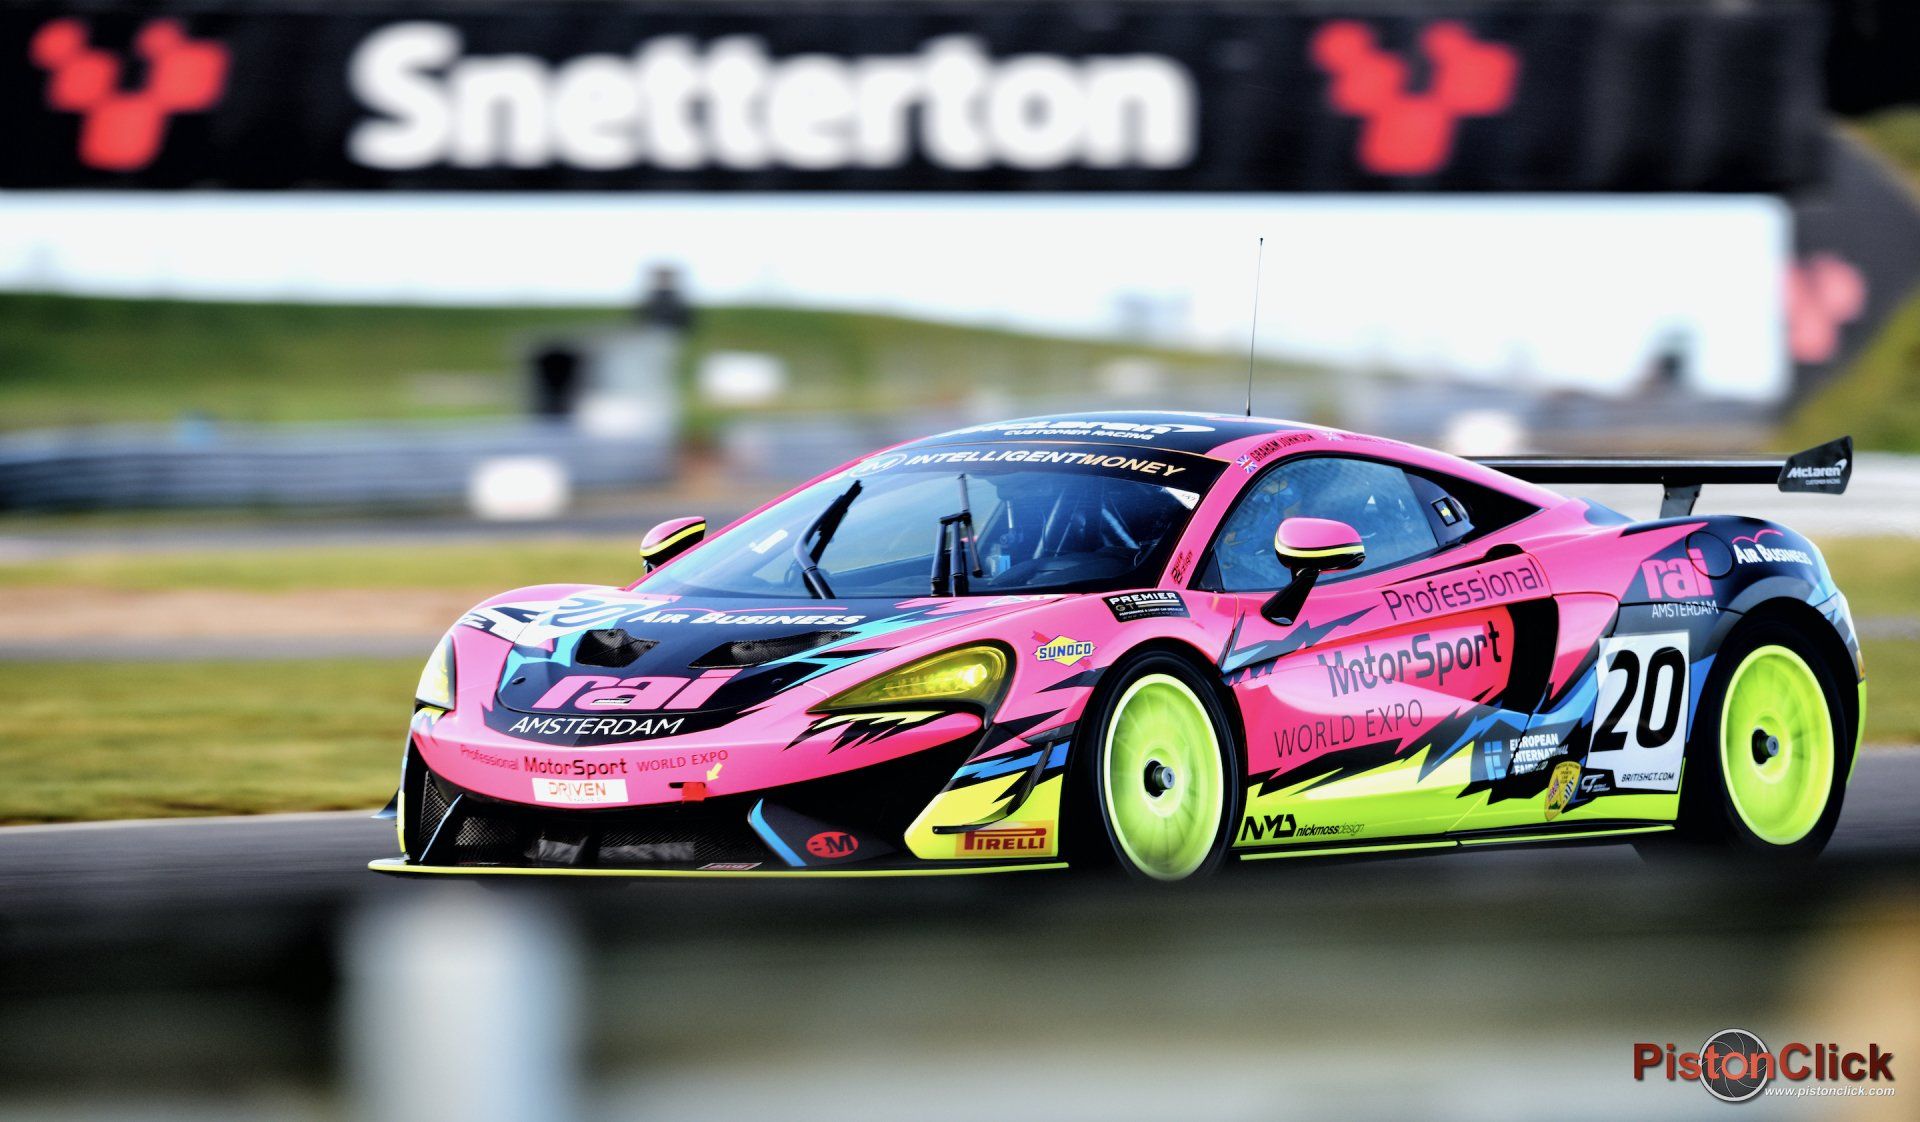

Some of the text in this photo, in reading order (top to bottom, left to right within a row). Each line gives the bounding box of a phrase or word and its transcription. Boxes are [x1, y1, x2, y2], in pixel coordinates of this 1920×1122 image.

[345, 20, 1193, 170] Snetterton
[1091, 430, 1155, 441] RACING
[1250, 439, 1282, 462] GRAHAM
[904, 450, 1187, 477] INTELLIGENTMONEY
[1786, 466, 1841, 478] McLaren
[1733, 544, 1813, 566] AIR BUSINESS
[1641, 548, 1714, 599] rai
[1108, 592, 1178, 606] PREMIER
[1381, 558, 1545, 621] Professional
[626, 611, 867, 625] AIR BUSINESS
[1651, 600, 1719, 619] AMSTERDAM
[1039, 642, 1092, 659] SUNOCO
[1317, 621, 1502, 697] MotorSport
[531, 668, 744, 711] rai
[1589, 646, 1686, 753] 20
[508, 716, 684, 735] AMSTERDAM
[1274, 699, 1423, 758] WORLD EXPO
[1509, 733, 1559, 751] EUROPEAN
[460, 744, 729, 779] Professional MotorSport WORLD EXPO
[548, 781, 607, 796] DRIVEN
[1621, 772, 1675, 783] BRITISHGT.COM
[964, 827, 1047, 851] PIRELLI
